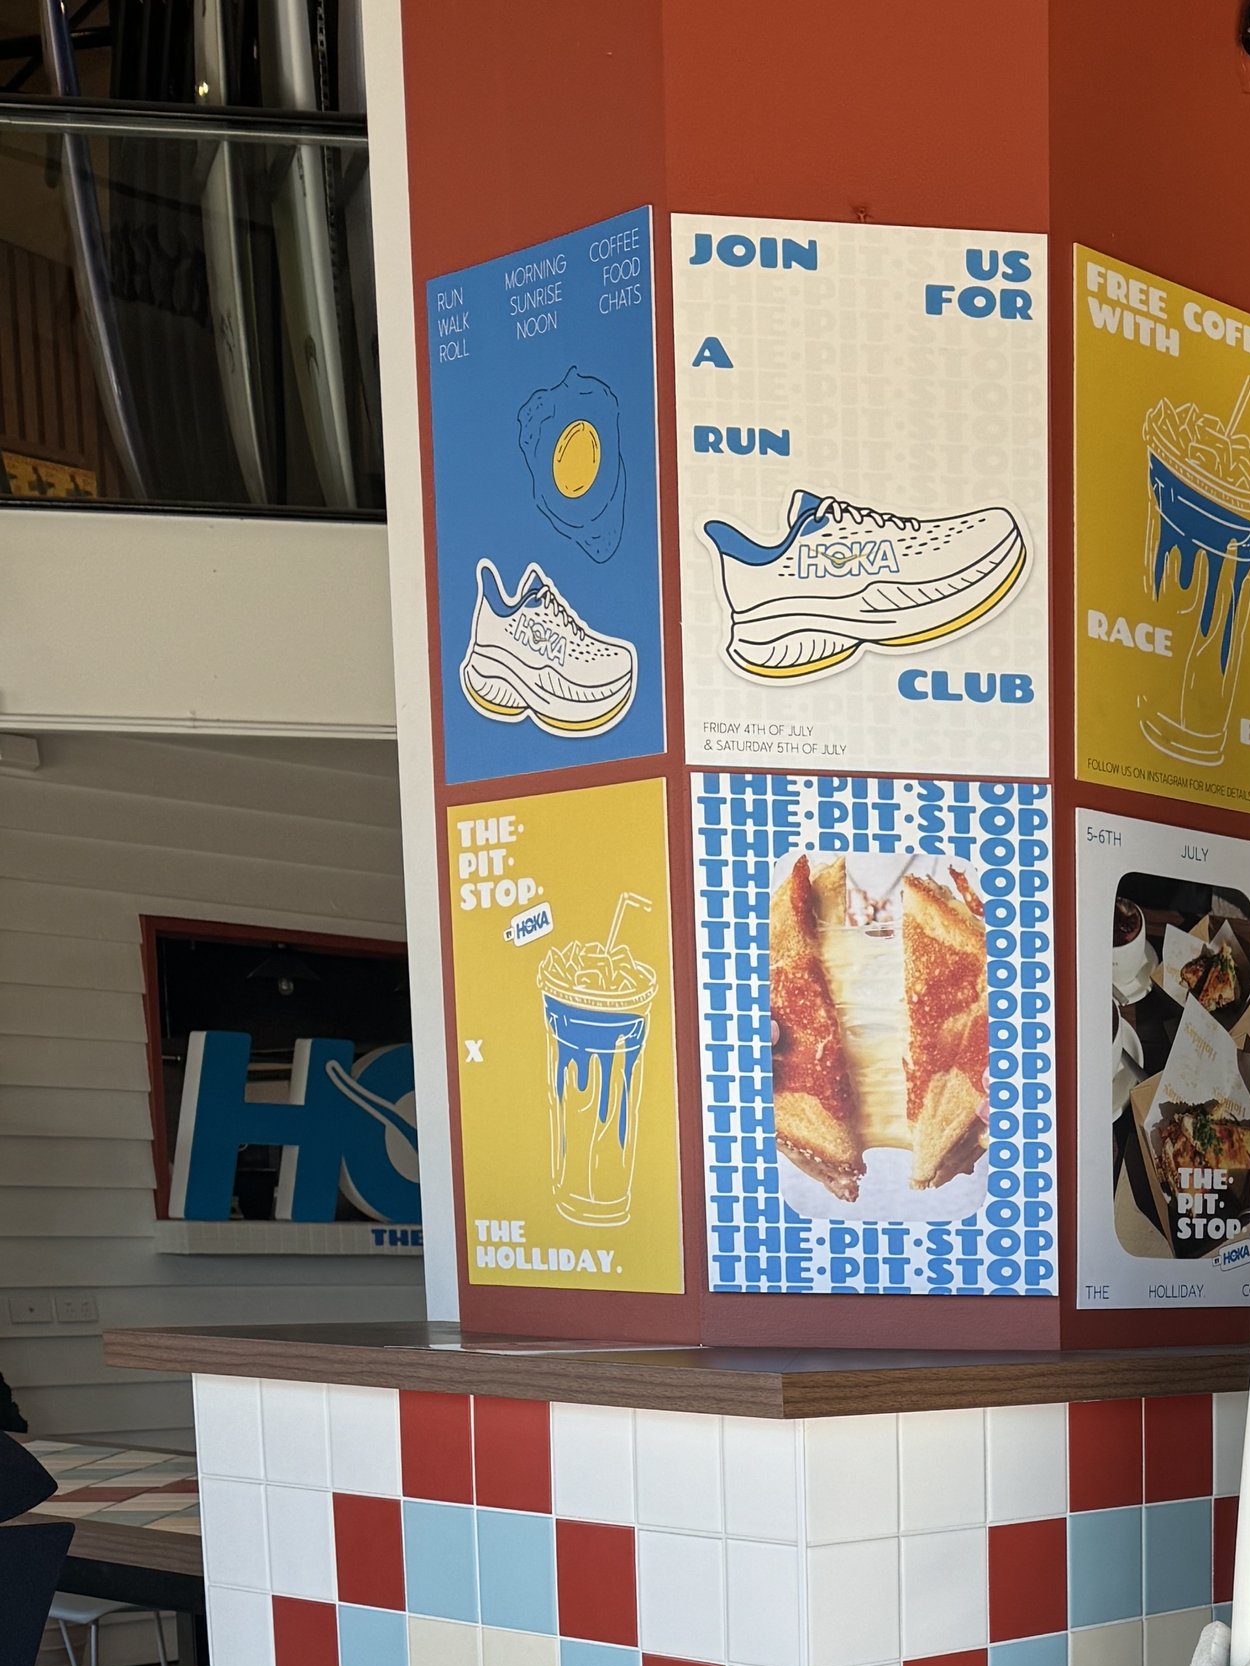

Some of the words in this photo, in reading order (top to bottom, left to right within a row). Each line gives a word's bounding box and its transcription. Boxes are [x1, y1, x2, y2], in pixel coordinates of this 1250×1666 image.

[589, 228, 640, 263] COFFEE
[689, 233, 818, 271] JOIN
[505, 254, 567, 291] MORNING
[603, 257, 641, 287] FOOD
[966, 248, 1032, 283] US
[437, 287, 464, 312] RUN
[510, 282, 562, 316] SUNRISE
[599, 283, 641, 314] CHATS
[924, 284, 1034, 320] FOR
[1087, 261, 1168, 320] FREE
[438, 312, 470, 337] WALK
[517, 311, 557, 340] NOON
[1087, 296, 1180, 357] WITH
[439, 339, 470, 363] ROLL
[692, 336, 734, 369] A
[693, 425, 790, 457] RUN
[798, 540, 900, 579] HOKA
[514, 613, 567, 666] HOKA
[1087, 609, 1173, 657] RACE
[898, 669, 1035, 704] CLUB
[703, 722, 741, 735] FRIDAY
[744, 723, 767, 735] 4TH
[769, 724, 785, 736] OF
[787, 724, 814, 737] JULY
[703, 739, 714, 751] &
[715, 739, 774, 754] SATURDAY
[777, 741, 799, 754] 5TH
[801, 742, 818, 755] OF
[820, 743, 847, 756] JULY
[1087, 758, 1120, 775] FOLLOW
[1121, 765, 1132, 777] US
[1133, 767, 1145, 779] ON
[1146, 769, 1188, 788] INSTAGRAM
[1189, 778, 1204, 791] FOR
[1205, 782, 1225, 796] MORE
[1087, 826, 1122, 847] 5-6TH
[1181, 845, 1209, 862] JULY
[516, 911, 550, 940] HOKA
[474, 1220, 526, 1243] THE
[476, 1246, 623, 1274] HOLLIDAY.
[1223, 1245, 1250, 1265] HOKA
[1085, 1286, 1110, 1300] THE
